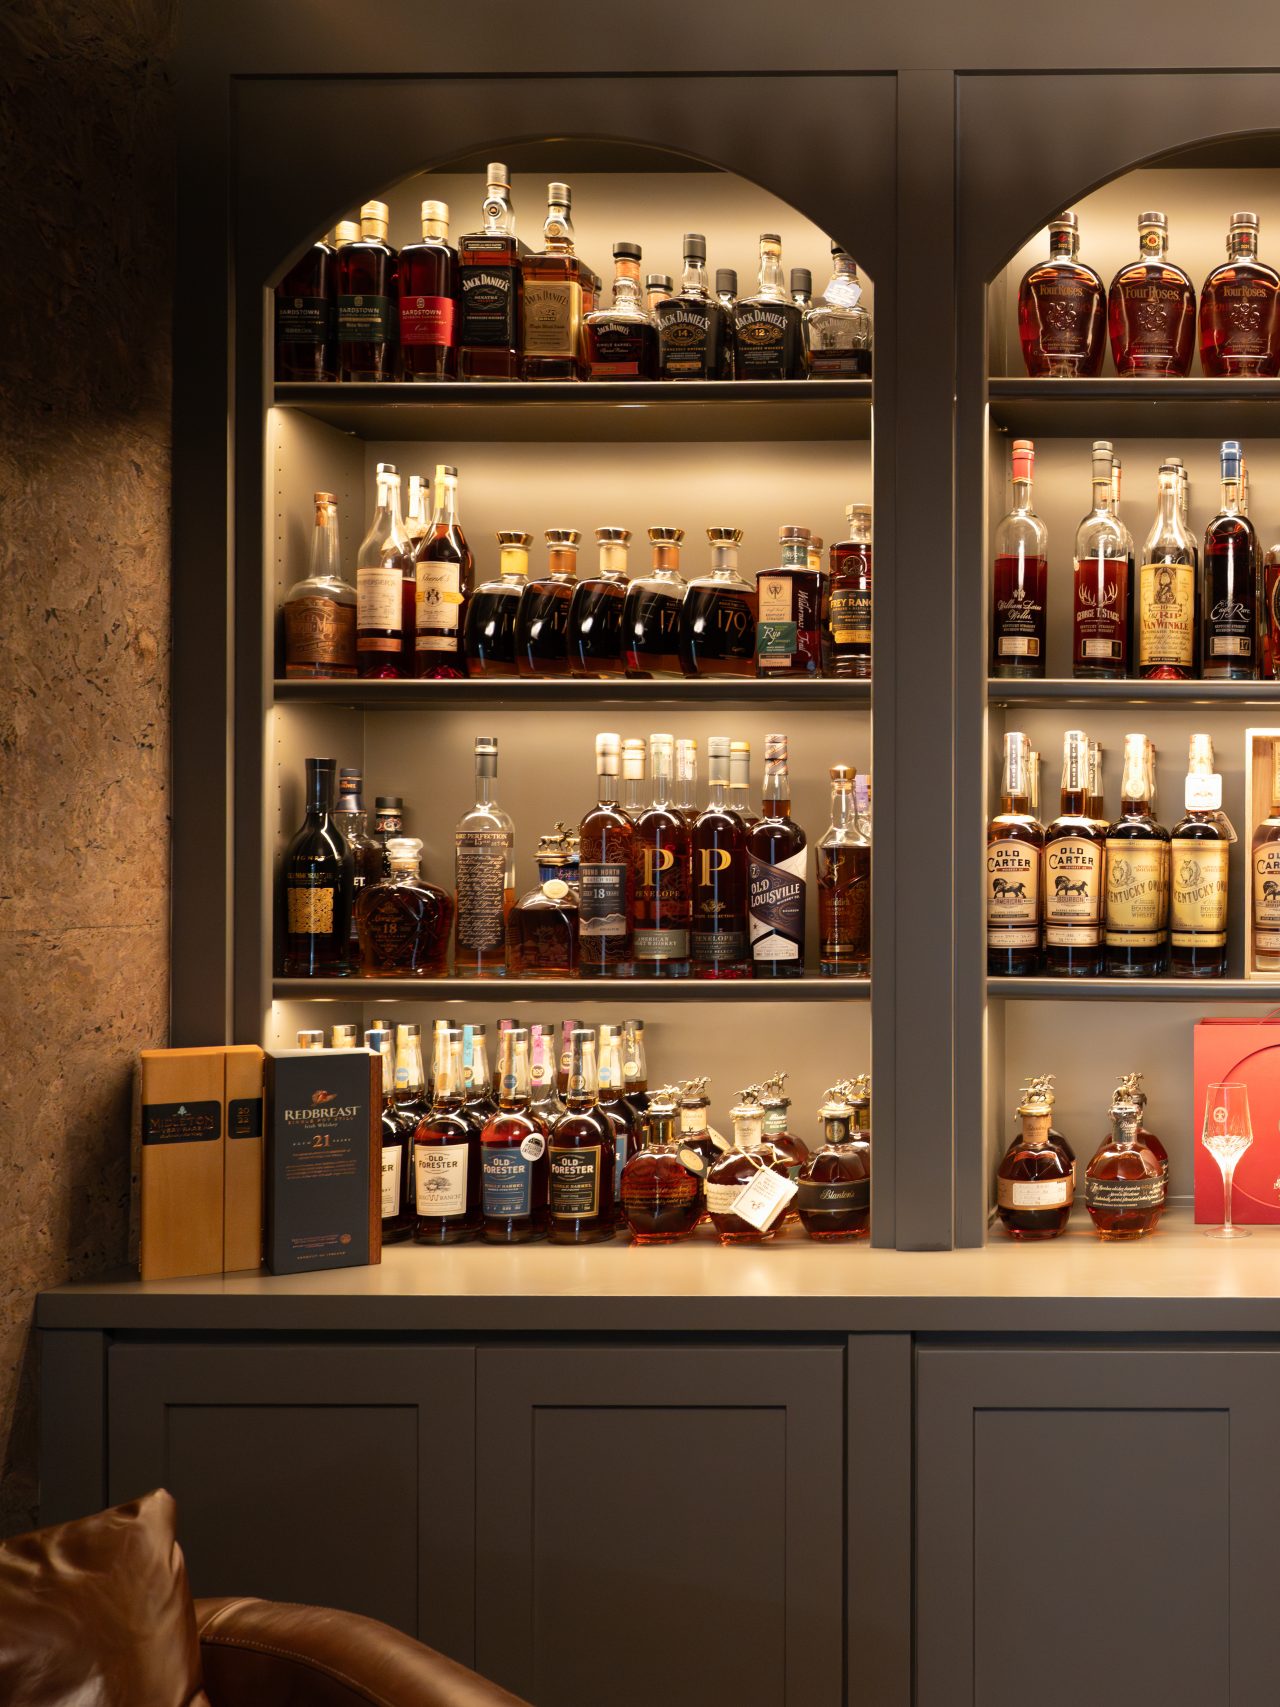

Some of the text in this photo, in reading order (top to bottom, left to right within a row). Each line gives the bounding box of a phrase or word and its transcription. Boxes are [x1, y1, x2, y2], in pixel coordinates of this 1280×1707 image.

[463, 274, 510, 292] JACK DANIEL'S
[1125, 287, 1179, 300] Four Roses
[658, 310, 710, 331] JACK DANIEL'S
[735, 310, 788, 331] JACK DANIEL'S
[598, 323, 630, 335] JACK DANIEL'S
[1077, 611, 1095, 622] GEORGE
[1102, 609, 1119, 621] STAGG
[1142, 621, 1189, 630] VAN WINKLE
[763, 626, 780, 645] Rye
[641, 848, 674, 886] P
[698, 848, 732, 886] P
[987, 857, 1030, 872] CARTER
[1049, 854, 1094, 870] CARTER
[594, 888, 605, 898] 18
[750, 883, 800, 907] LOUISVILLE
[752, 880, 769, 895] OLD
[1173, 883, 1212, 904] KENTUCKY
[383, 921, 397, 934] 18
[284, 1105, 360, 1121] REDBREAST
[419, 1160, 458, 1168] FORESTER
[483, 1165, 525, 1174] FORESTER
[493, 1158, 510, 1166] OLD
[551, 1165, 594, 1174] FORESTER
[820, 1190, 855, 1200] Blanton's
